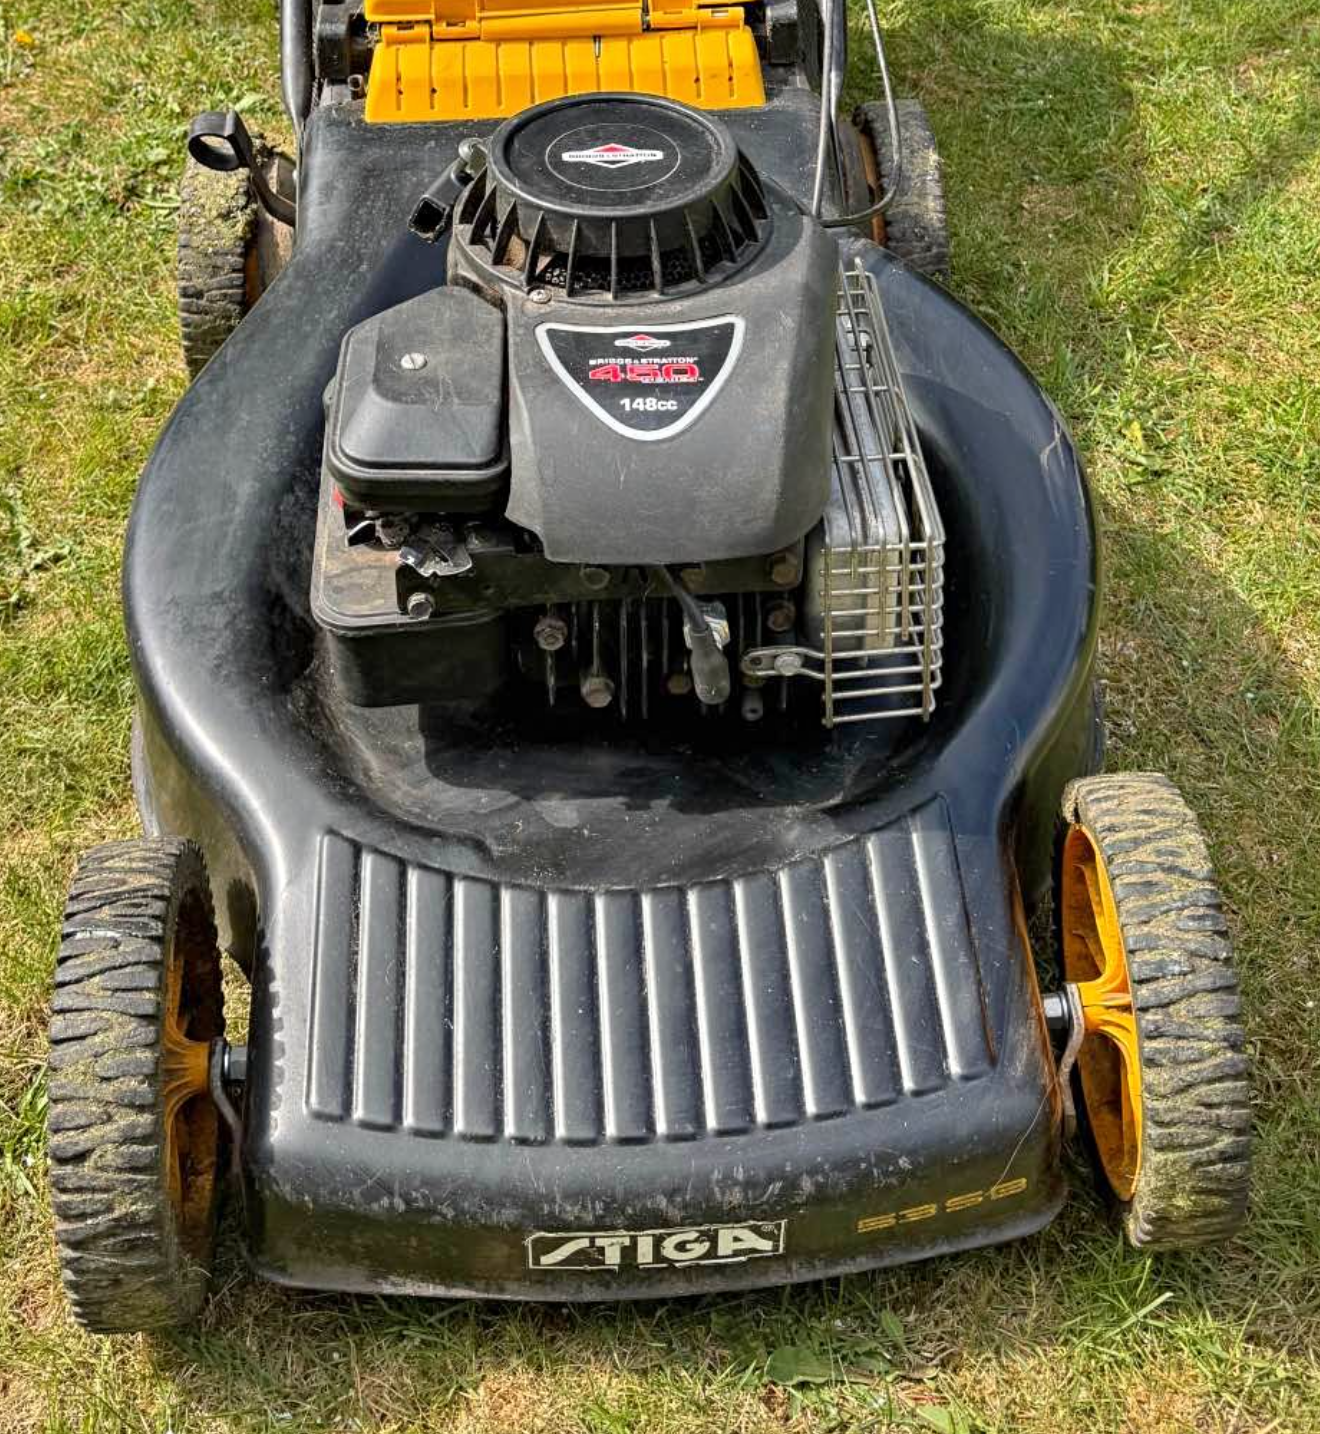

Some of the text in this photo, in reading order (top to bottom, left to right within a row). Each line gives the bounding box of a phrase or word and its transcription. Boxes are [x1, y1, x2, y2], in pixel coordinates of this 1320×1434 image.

[588, 363, 699, 383] 450
[619, 397, 678, 412] 148cc
[539, 1227, 774, 1266] STIGA
